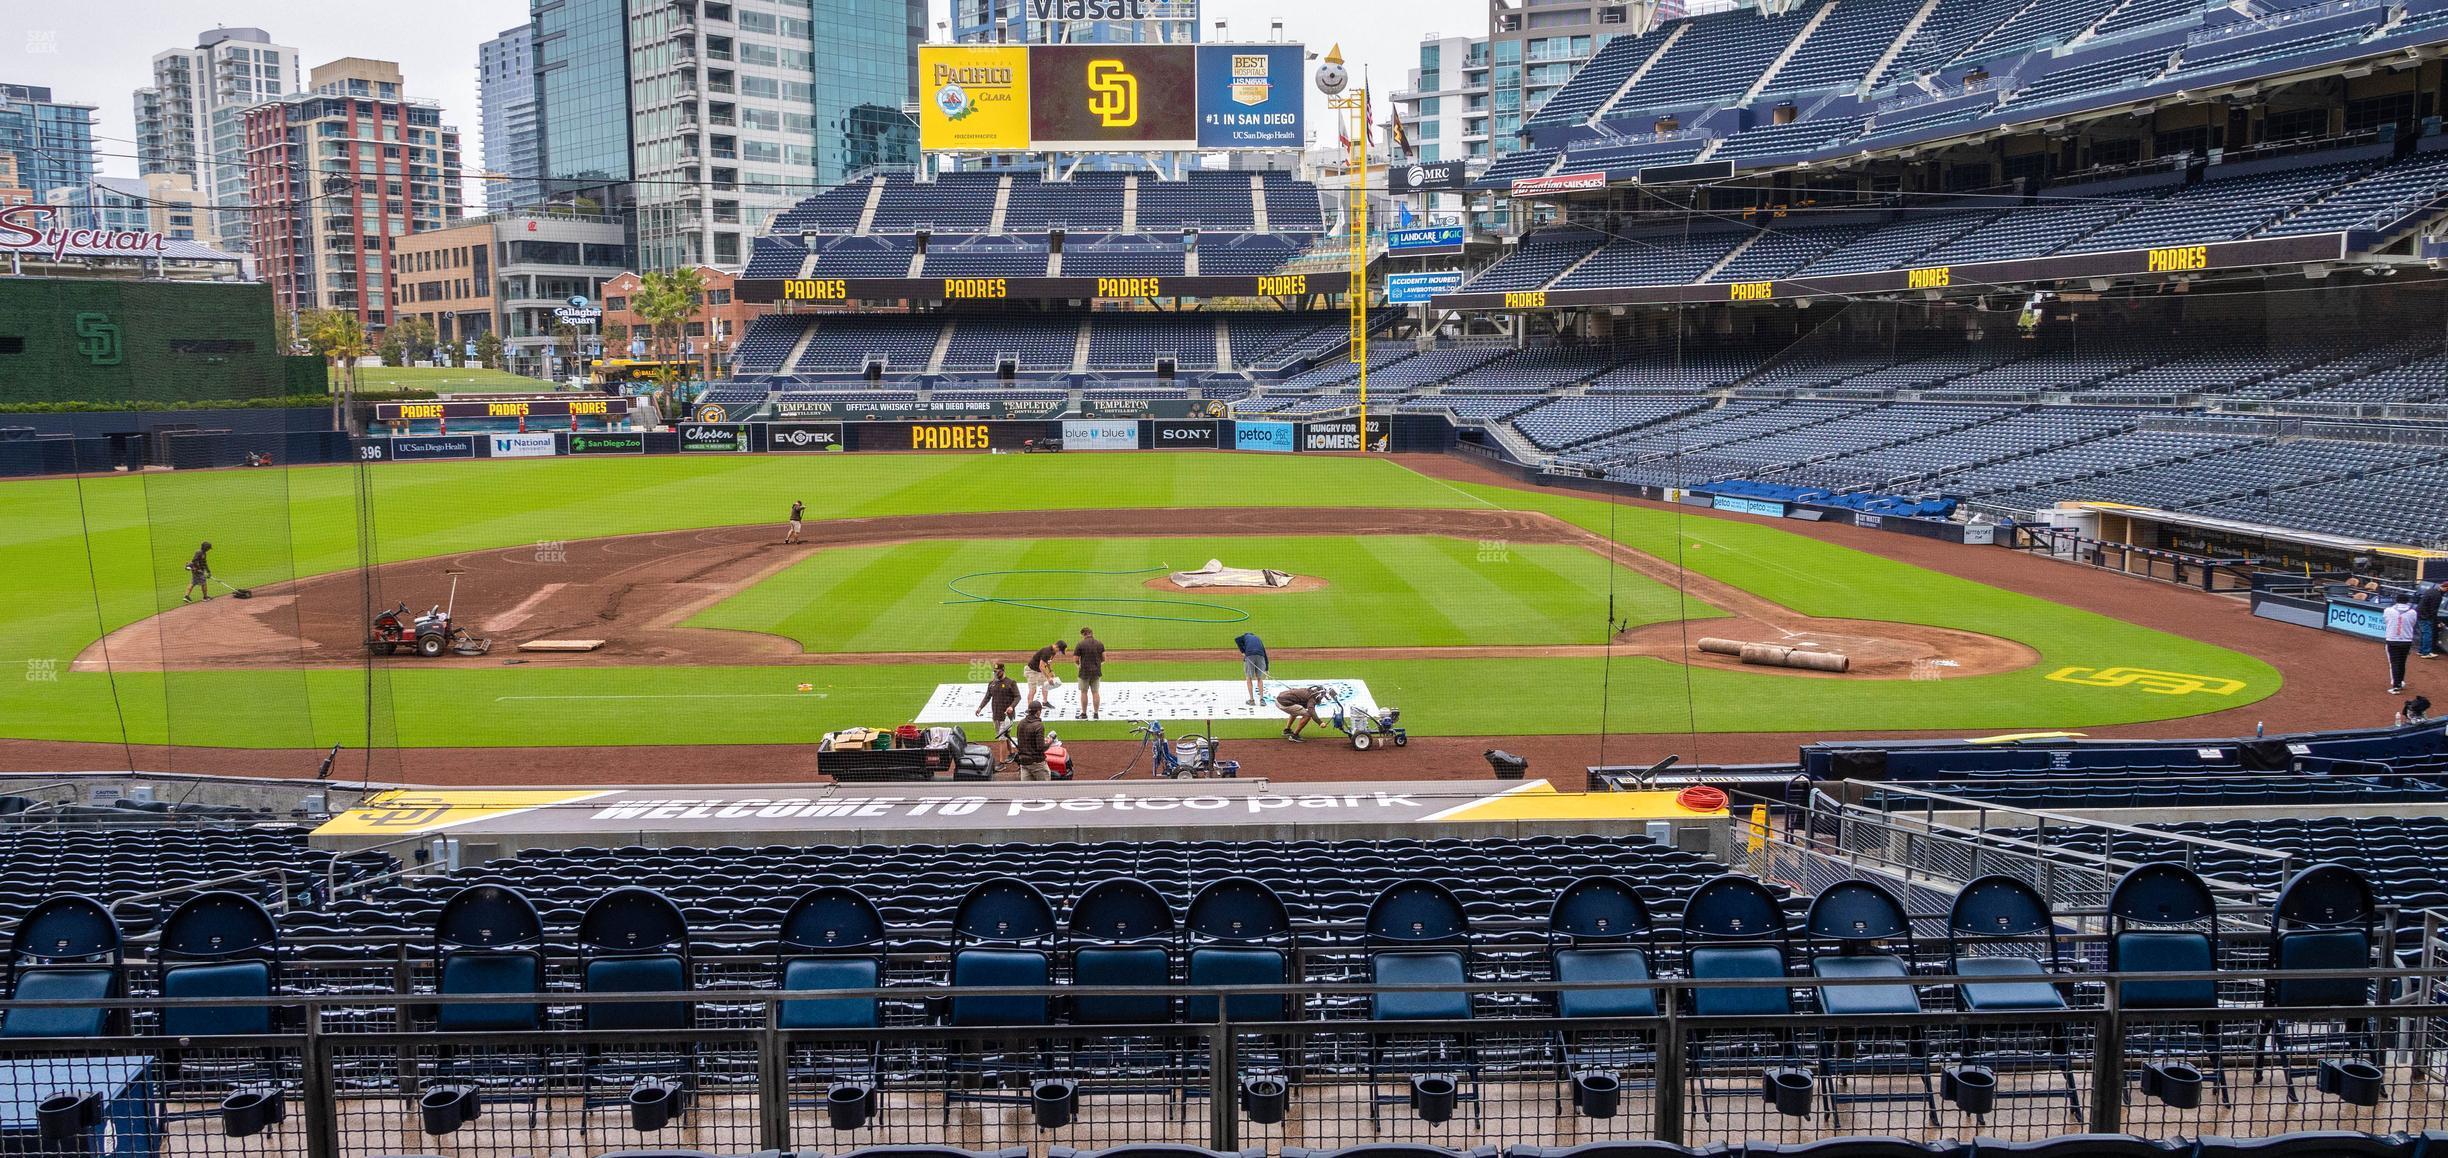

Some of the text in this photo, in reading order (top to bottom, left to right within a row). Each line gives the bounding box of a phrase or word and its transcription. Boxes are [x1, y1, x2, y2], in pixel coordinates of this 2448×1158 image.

[1234, 57, 1266, 68] BEST
[1234, 68, 1266, 76] HOSPITALS
[1206, 113, 1295, 125] #1 IN SAN DIEGO
[1233, 131, 1295, 140] UC San Diego Health
[1424, 168, 1450, 180] MRC
[1563, 179, 1603, 188] SAUSAGES
[0, 205, 169, 262] Sycuan
[1400, 231, 1437, 242] LANDCARE
[2148, 245, 2206, 272] PADRES
[1391, 276, 1460, 285] ACCIDENT? INJURED?
[1908, 266, 1950, 288] PADRES
[784, 280, 846, 299] PADRES
[945, 279, 1006, 298] PADRES
[1098, 278, 1159, 297] PADRES
[1257, 275, 1306, 295] PADRES
[1403, 285, 1460, 293] LAWBROTHERS.CO
[1730, 281, 1772, 299] PADRES
[1505, 292, 1545, 307] PADRES
[554, 307, 602, 318] Gallagher
[561, 316, 596, 326] Square
[776, 403, 832, 412] TEMPLETON
[846, 403, 879, 411] OFFICIAL
[880, 403, 913, 411] WHISKEY
[931, 402, 944, 410] SAN
[945, 402, 964, 410] DIEGO
[965, 402, 990, 410] PADRES
[1003, 401, 1059, 410] TEMPLETON
[1093, 400, 1149, 410] TEMPLETON
[685, 426, 733, 440] Chosen
[1065, 429, 1088, 438] blue
[1101, 429, 1125, 438] blue
[1310, 423, 1356, 433] HUNGRY FOR
[912, 426, 989, 449] PADRES
[1163, 429, 1212, 440] SONY
[1239, 428, 1273, 443] petco
[399, 442, 467, 452] UC San Diego Health
[514, 437, 551, 447] National
[588, 439, 640, 449] San Diego Zoo
[1307, 434, 1361, 449] HOMERS
[361, 446, 382, 460] 396
[2330, 607, 2366, 625] petco
[590, 792, 1423, 819] WELCOME TO petco park
